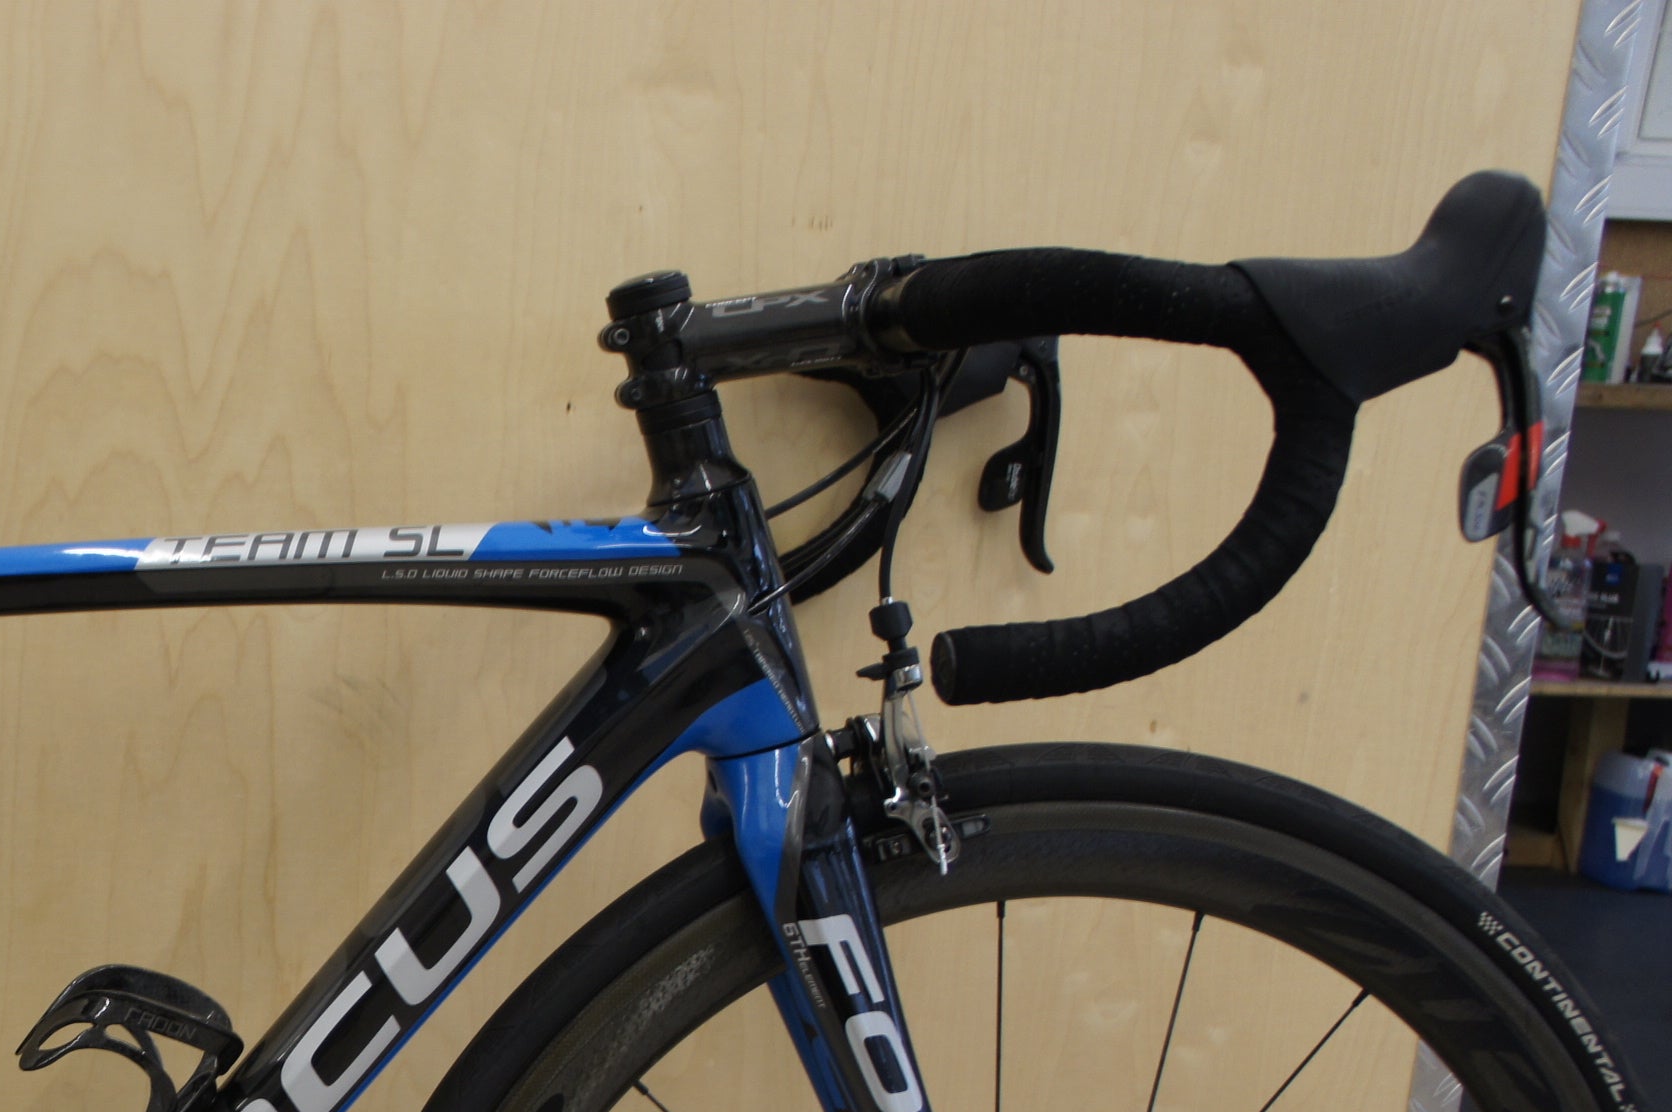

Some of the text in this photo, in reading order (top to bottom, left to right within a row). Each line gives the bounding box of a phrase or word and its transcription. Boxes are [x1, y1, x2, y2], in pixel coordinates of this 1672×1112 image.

[162, 525, 468, 566] TEAM SL
[473, 568, 524, 579] SHAPE
[628, 564, 683, 577] DESIGN
[1495, 931, 1626, 1102] CONTINENTAL
